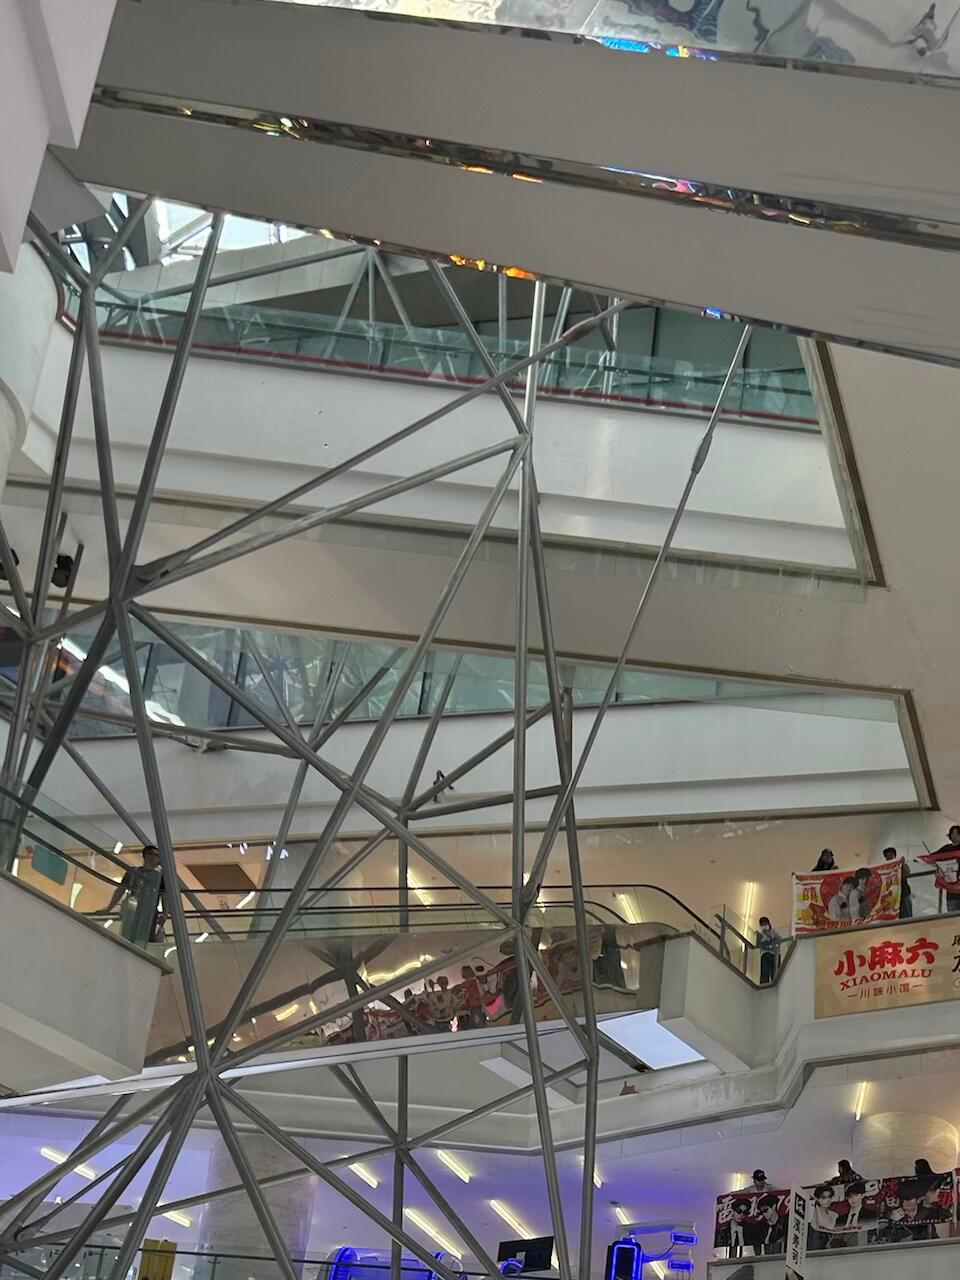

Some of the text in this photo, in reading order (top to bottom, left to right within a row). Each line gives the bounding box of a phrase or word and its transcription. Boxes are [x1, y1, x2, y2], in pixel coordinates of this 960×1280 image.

[834, 937, 939, 977] 小麻六
[840, 969, 934, 991] XIAOMALU
